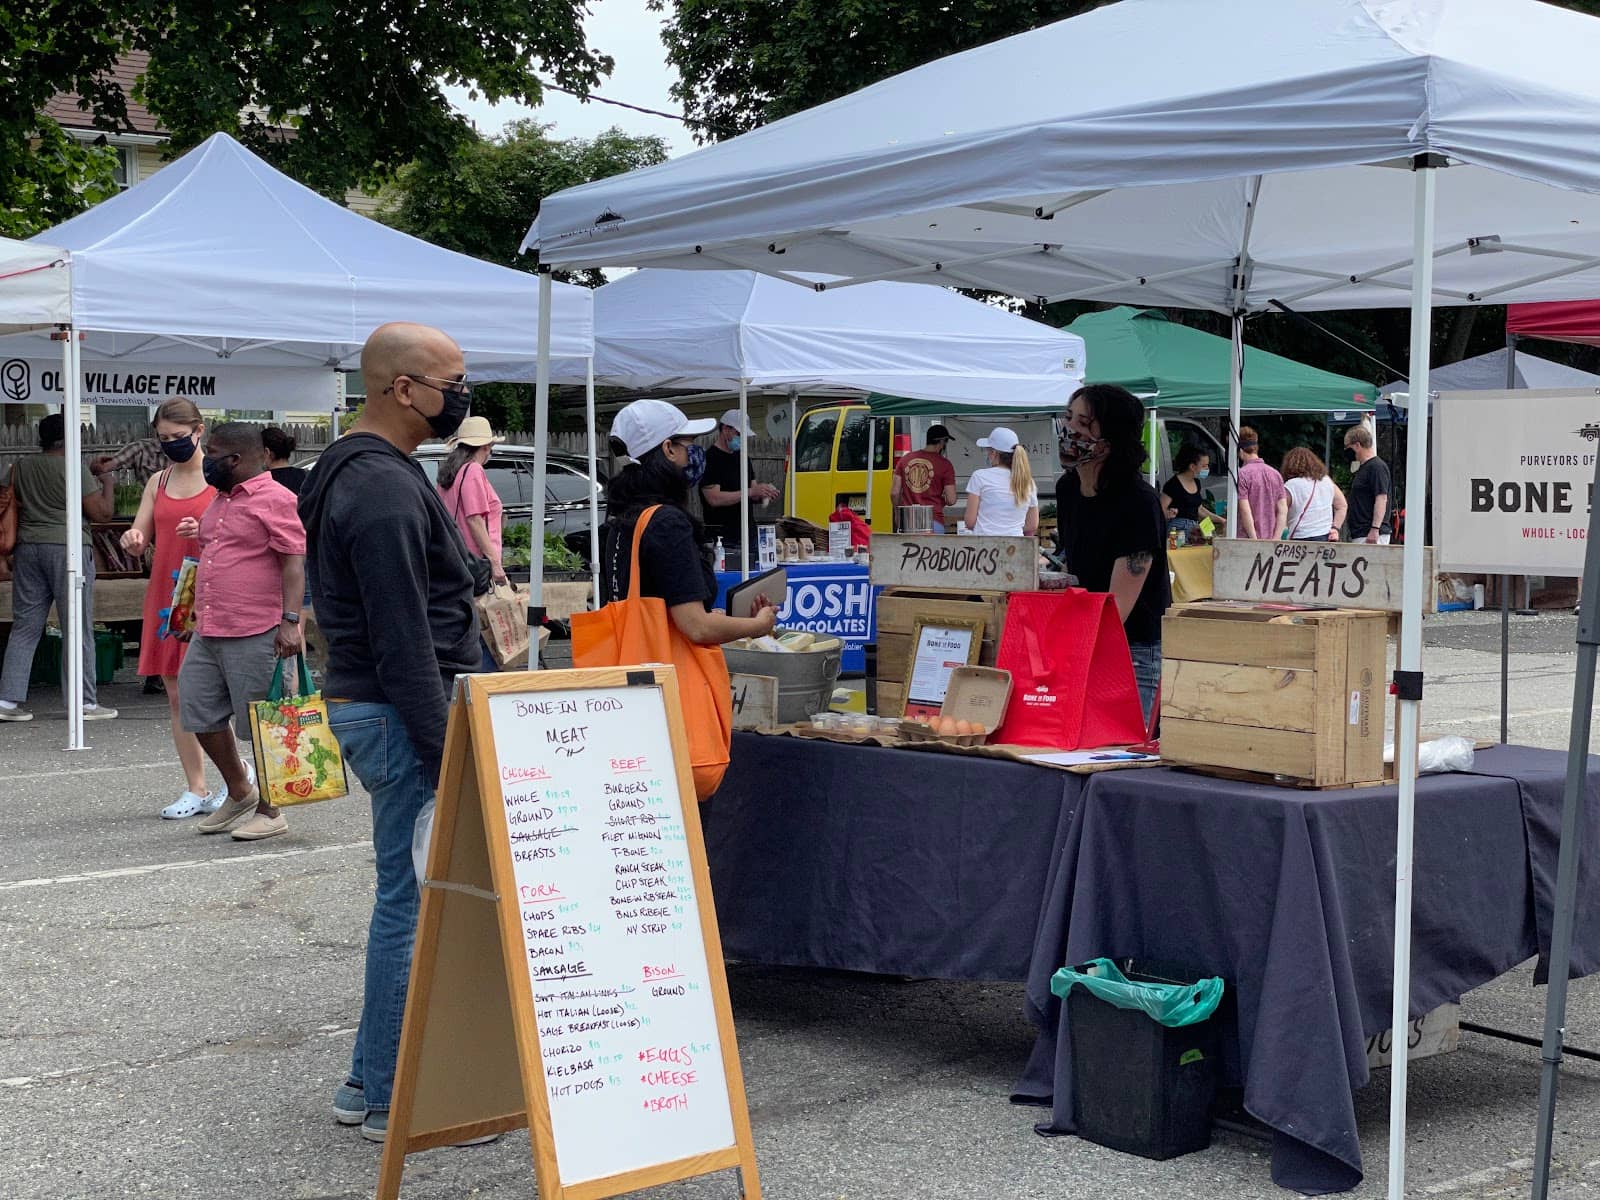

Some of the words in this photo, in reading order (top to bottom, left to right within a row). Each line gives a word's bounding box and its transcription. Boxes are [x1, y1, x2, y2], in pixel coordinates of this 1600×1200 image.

[41, 371, 64, 392] OL
[85, 372, 160, 394] VILLAGE
[165, 375, 216, 396] FARM
[1520, 455, 1578, 466] PURVEYORS
[1583, 455, 1595, 466] OF
[1471, 478, 1573, 513] BONE
[1522, 527, 1555, 539] WHOLE
[1567, 528, 1585, 539] LOC
[900, 542, 999, 575] PROBIOTICS
[1275, 543, 1337, 560] GRASS-FED
[1245, 552, 1369, 598] MEATS
[777, 583, 867, 621] JOSH
[512, 699, 577, 717] BONE-IN
[586, 697, 623, 712] FOOD
[547, 726, 588, 743] MEAT
[609, 757, 647, 768] BEEF
[502, 765, 546, 780] CHICKEN
[604, 781, 648, 795] BURGERS
[505, 791, 540, 807] WHOLE
[609, 799, 645, 811] GROUND
[509, 807, 553, 825] GROUND
[601, 832, 624, 842] FILET
[628, 828, 661, 841] MIGNON
[514, 848, 556, 862] BREASTS
[611, 847, 648, 858] T-BONE
[615, 863, 640, 875] RANCH
[641, 862, 667, 872] STEAK
[616, 878, 637, 891] CHIP
[639, 876, 668, 888] STEAK
[523, 910, 555, 921] CHOPS
[527, 928, 558, 939] SPARE
[562, 925, 587, 935] RIBS
[627, 924, 638, 936] NY
[641, 923, 667, 934] STRIP
[528, 945, 564, 959] BACON
[533, 961, 587, 976] SAUSAGE
[642, 964, 675, 978] BISON
[652, 985, 685, 997] GROUND
[537, 1010, 552, 1018] HOT
[556, 1008, 589, 1018] ITALIAN
[540, 1026, 564, 1037] SAGE
[543, 1044, 582, 1058] CHORIZO
[646, 1046, 692, 1066] EGGS
[547, 1059, 594, 1077] KIELBASA
[648, 1070, 698, 1086] CHEESE
[551, 1084, 571, 1098] HOT
[575, 1078, 604, 1095] DOGS
[651, 1093, 688, 1112] BROTH
